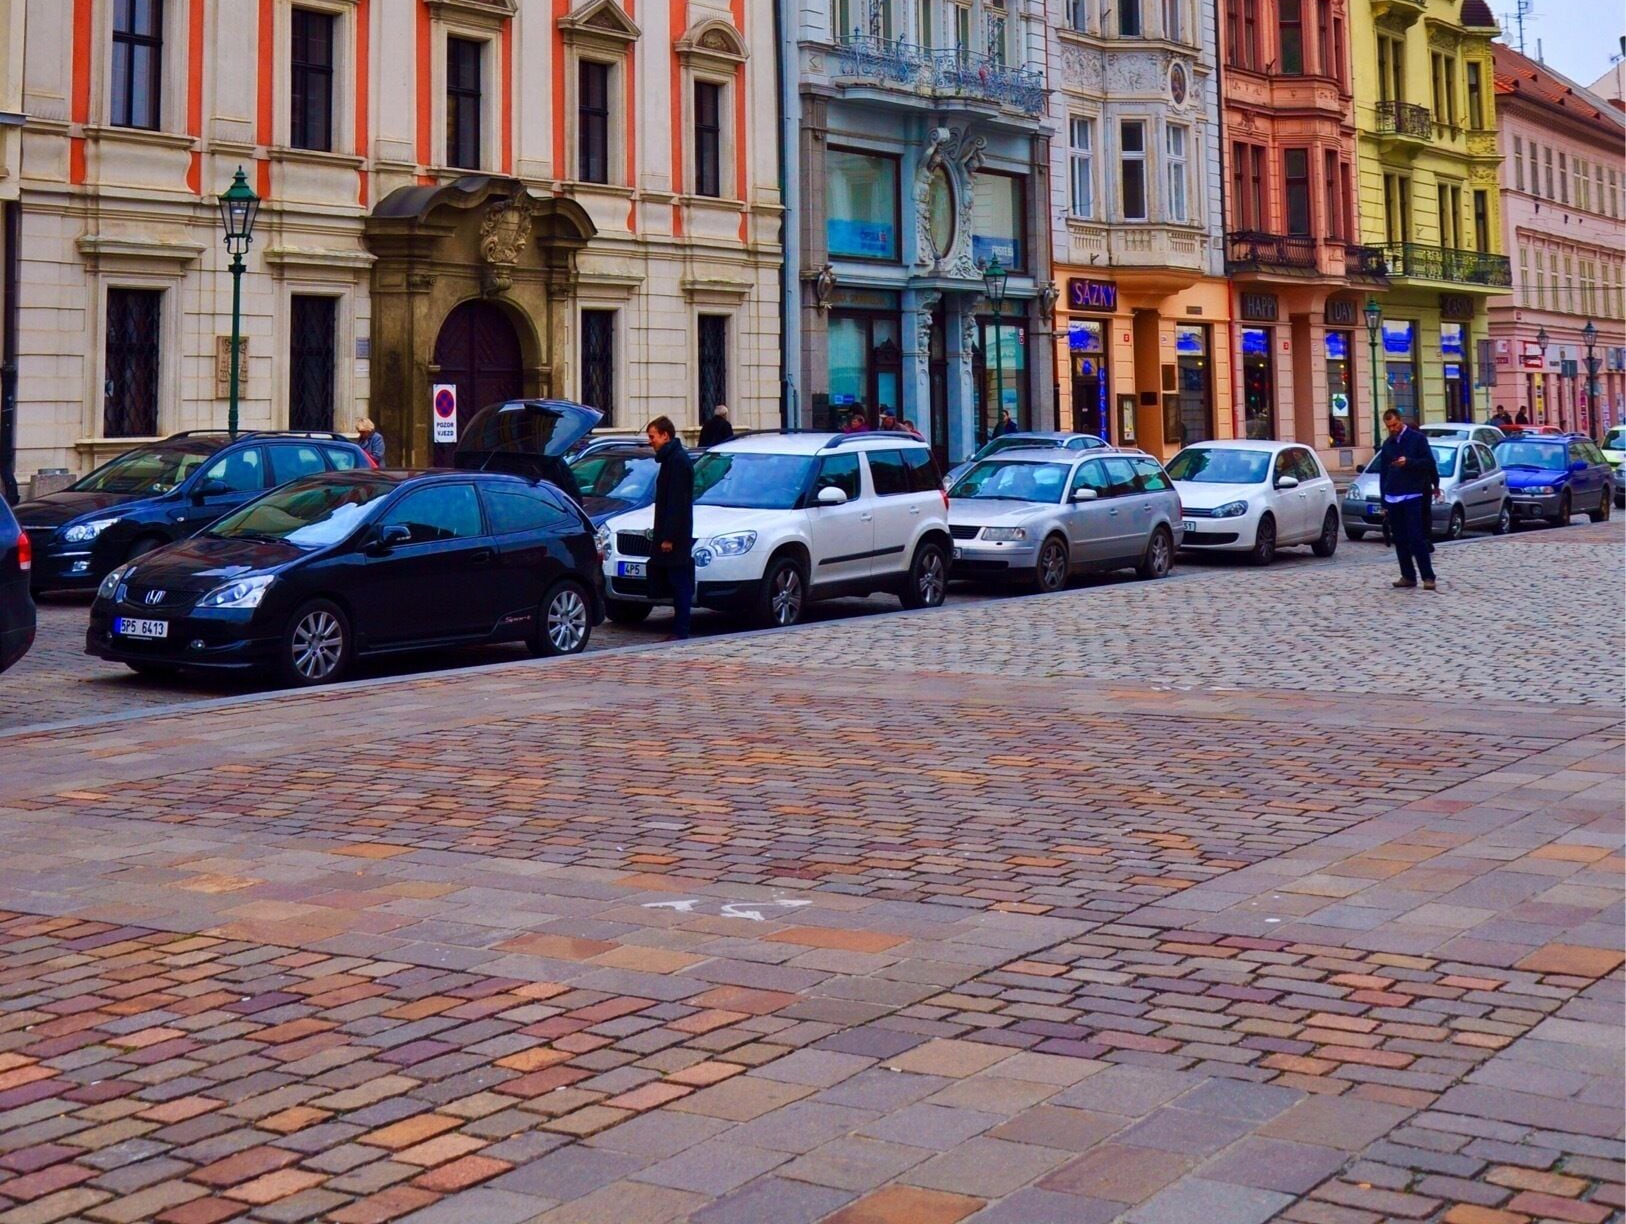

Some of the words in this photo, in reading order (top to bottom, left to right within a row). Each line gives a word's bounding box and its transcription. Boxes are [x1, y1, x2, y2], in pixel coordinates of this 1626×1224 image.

[1075, 280, 1116, 307] SÁZKY
[1334, 301, 1353, 321] DAY
[625, 564, 640, 575] 4P5
[121, 619, 137, 633] 5P5
[141, 621, 164, 636] 6413
